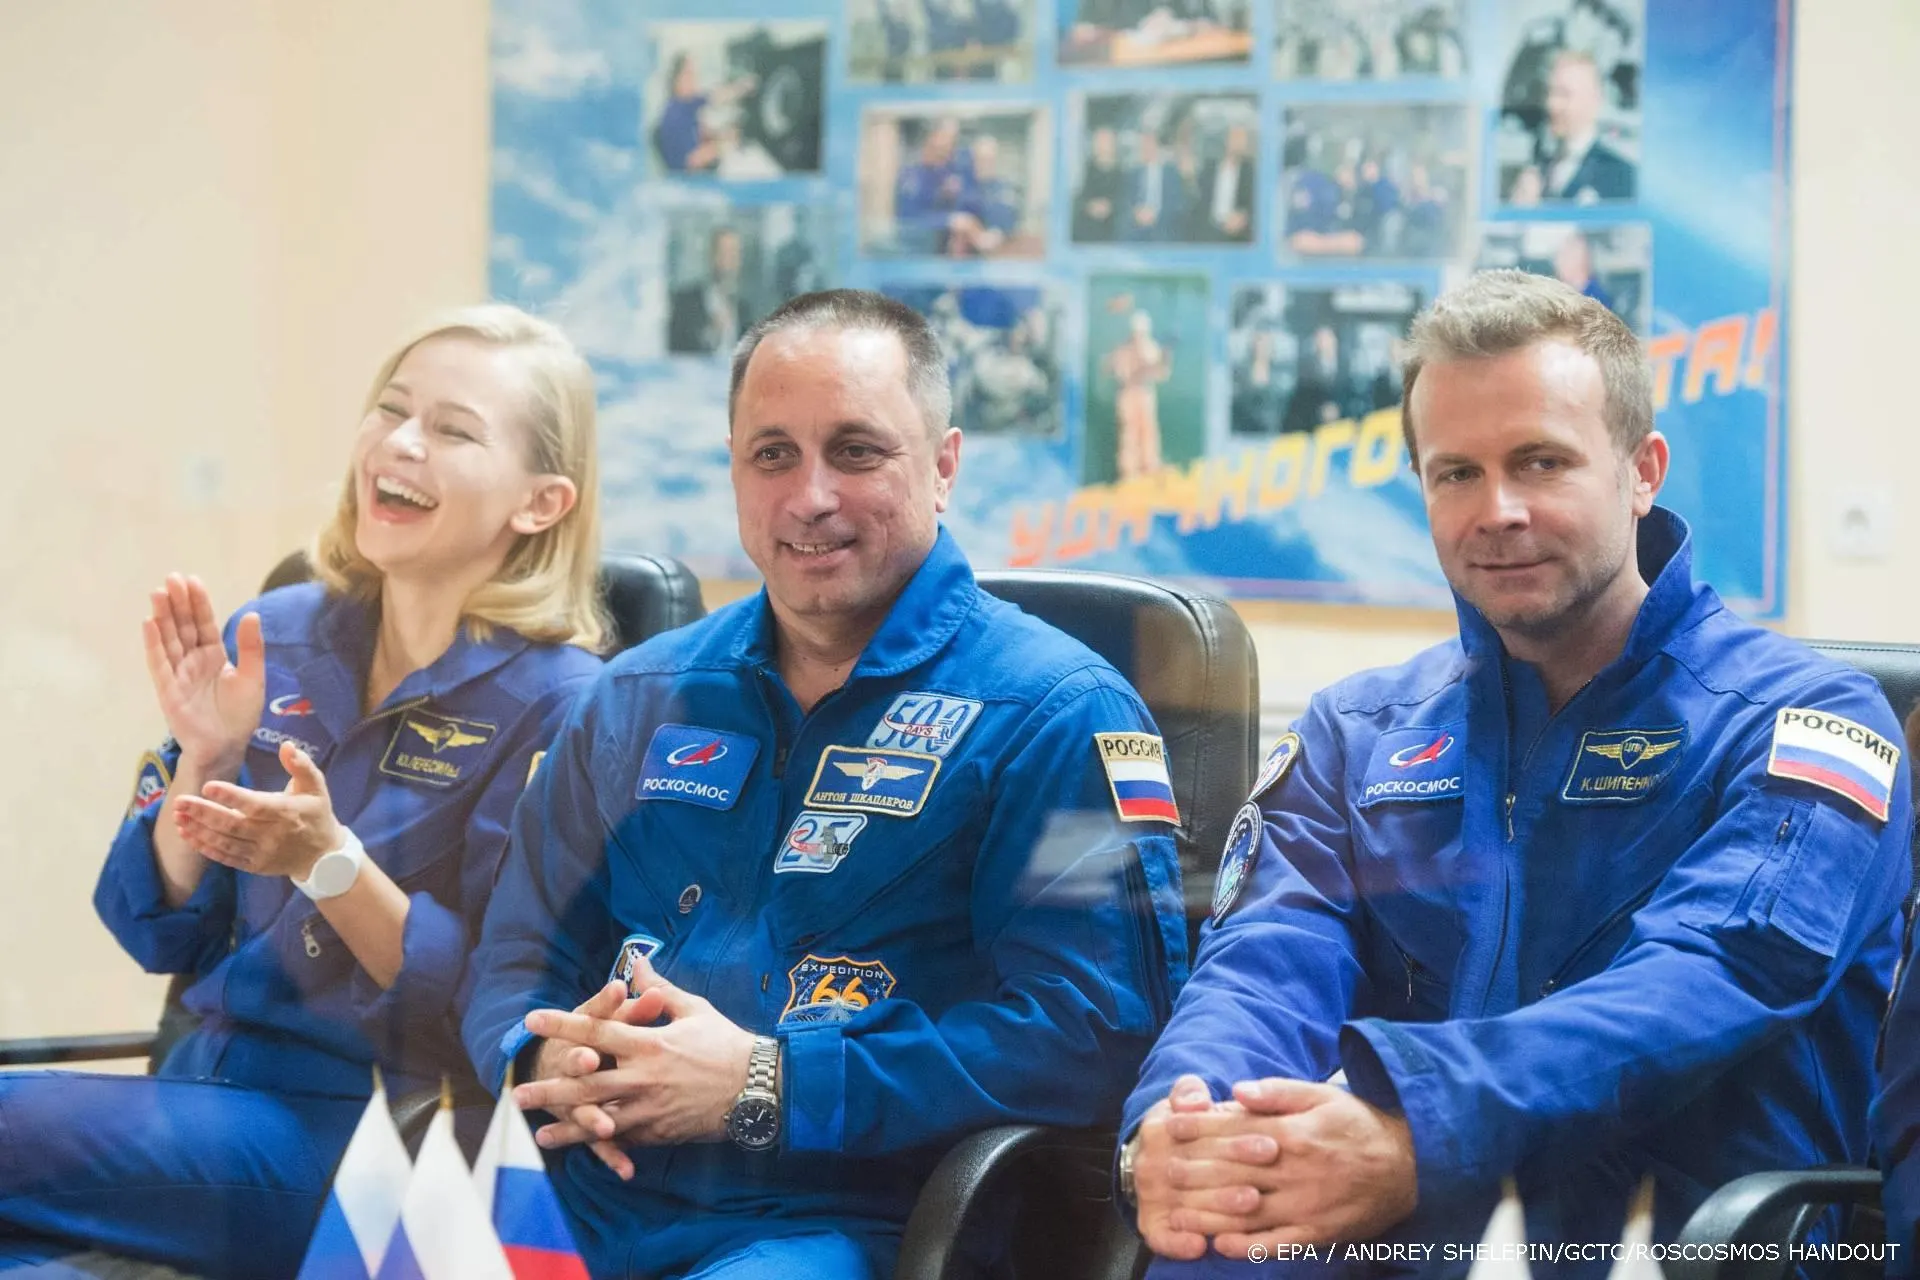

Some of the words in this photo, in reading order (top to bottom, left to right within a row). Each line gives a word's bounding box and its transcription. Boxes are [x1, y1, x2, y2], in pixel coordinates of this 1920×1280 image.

[1648, 308, 1776, 408] ТА!
[875, 699, 970, 752] 500
[904, 725, 934, 736] DAYS
[1103, 739, 1163, 759] РОССИЯ
[1783, 712, 1894, 764] РОССИЯ
[642, 778, 730, 801] РОСКОСМОС
[813, 791, 847, 803] АНТОН
[1366, 777, 1461, 800] РОСКОСМОС
[800, 963, 884, 980] EXPEDITION
[811, 973, 869, 1009] 66
